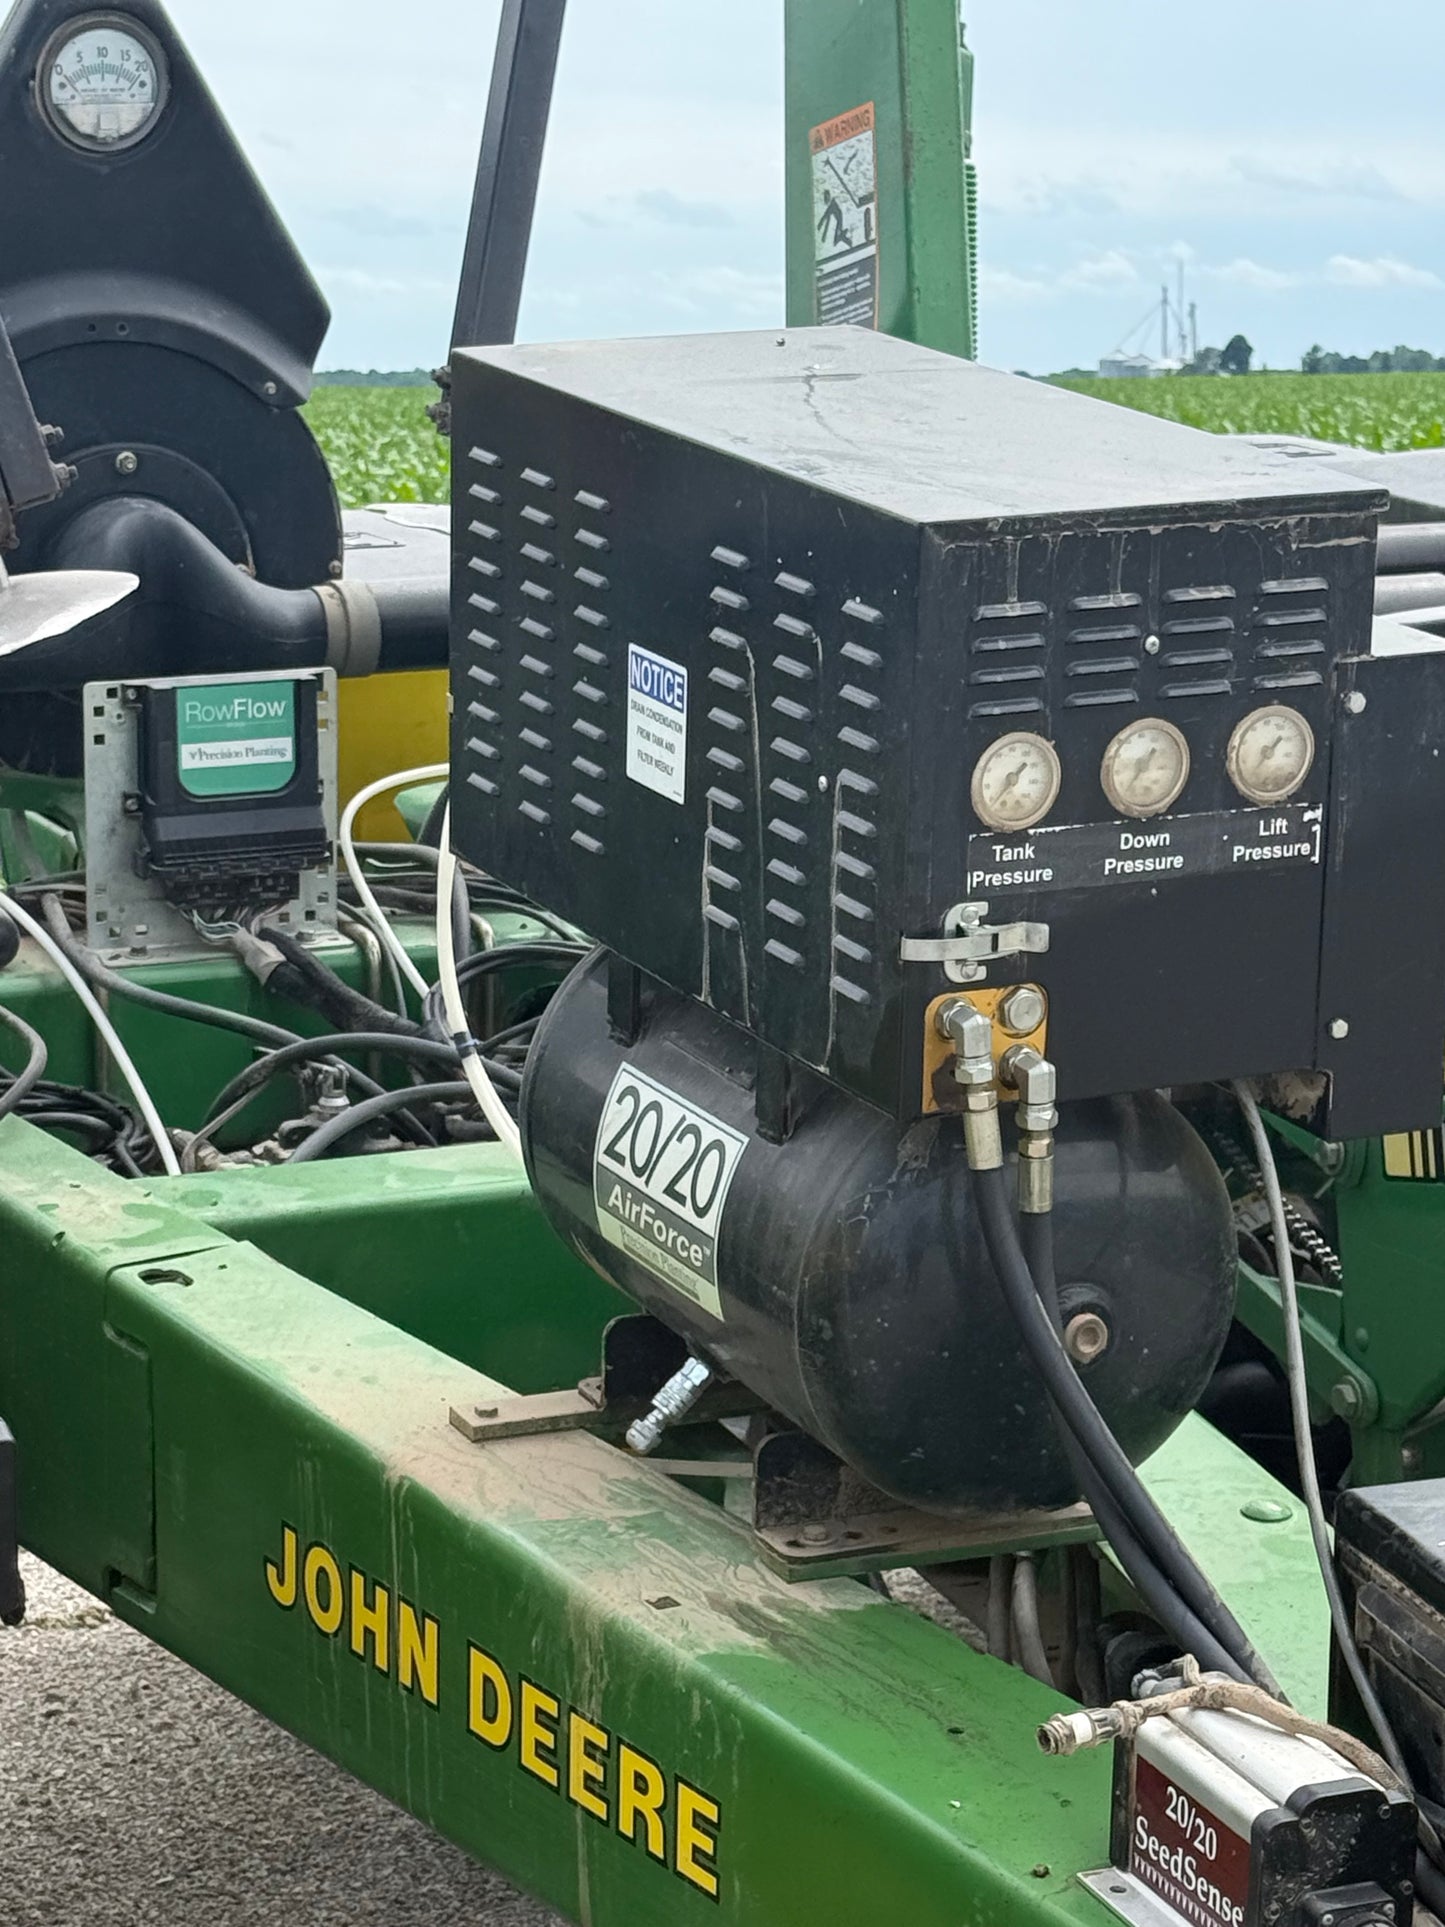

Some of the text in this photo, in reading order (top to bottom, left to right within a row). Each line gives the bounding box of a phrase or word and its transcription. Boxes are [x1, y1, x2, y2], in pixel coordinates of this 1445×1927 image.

[54, 46, 148, 76] 0 5 10 15 20
[824, 108, 871, 146] WARNING
[630, 653, 684, 710] NOTICE
[185, 698, 286, 723] RowFlow
[630, 699, 645, 717] DRAIN
[199, 745, 288, 761] Precision Planting
[636, 725, 677, 755] FROM TANK AND
[637, 749, 676, 777] FILTER WEEKLY
[1259, 818, 1289, 837] Lift
[992, 843, 1035, 863] Tank
[1120, 832, 1171, 851] Down
[1232, 842, 1312, 863] Pressure
[1104, 854, 1184, 876] Pressure
[972, 868, 1054, 889] Pressure
[603, 1085, 727, 1219] 20/20
[264, 1521, 720, 1902] JOHN DEERE
[1165, 1785, 1217, 1861] 20/20
[1135, 1815, 1244, 1927] SeedSense
